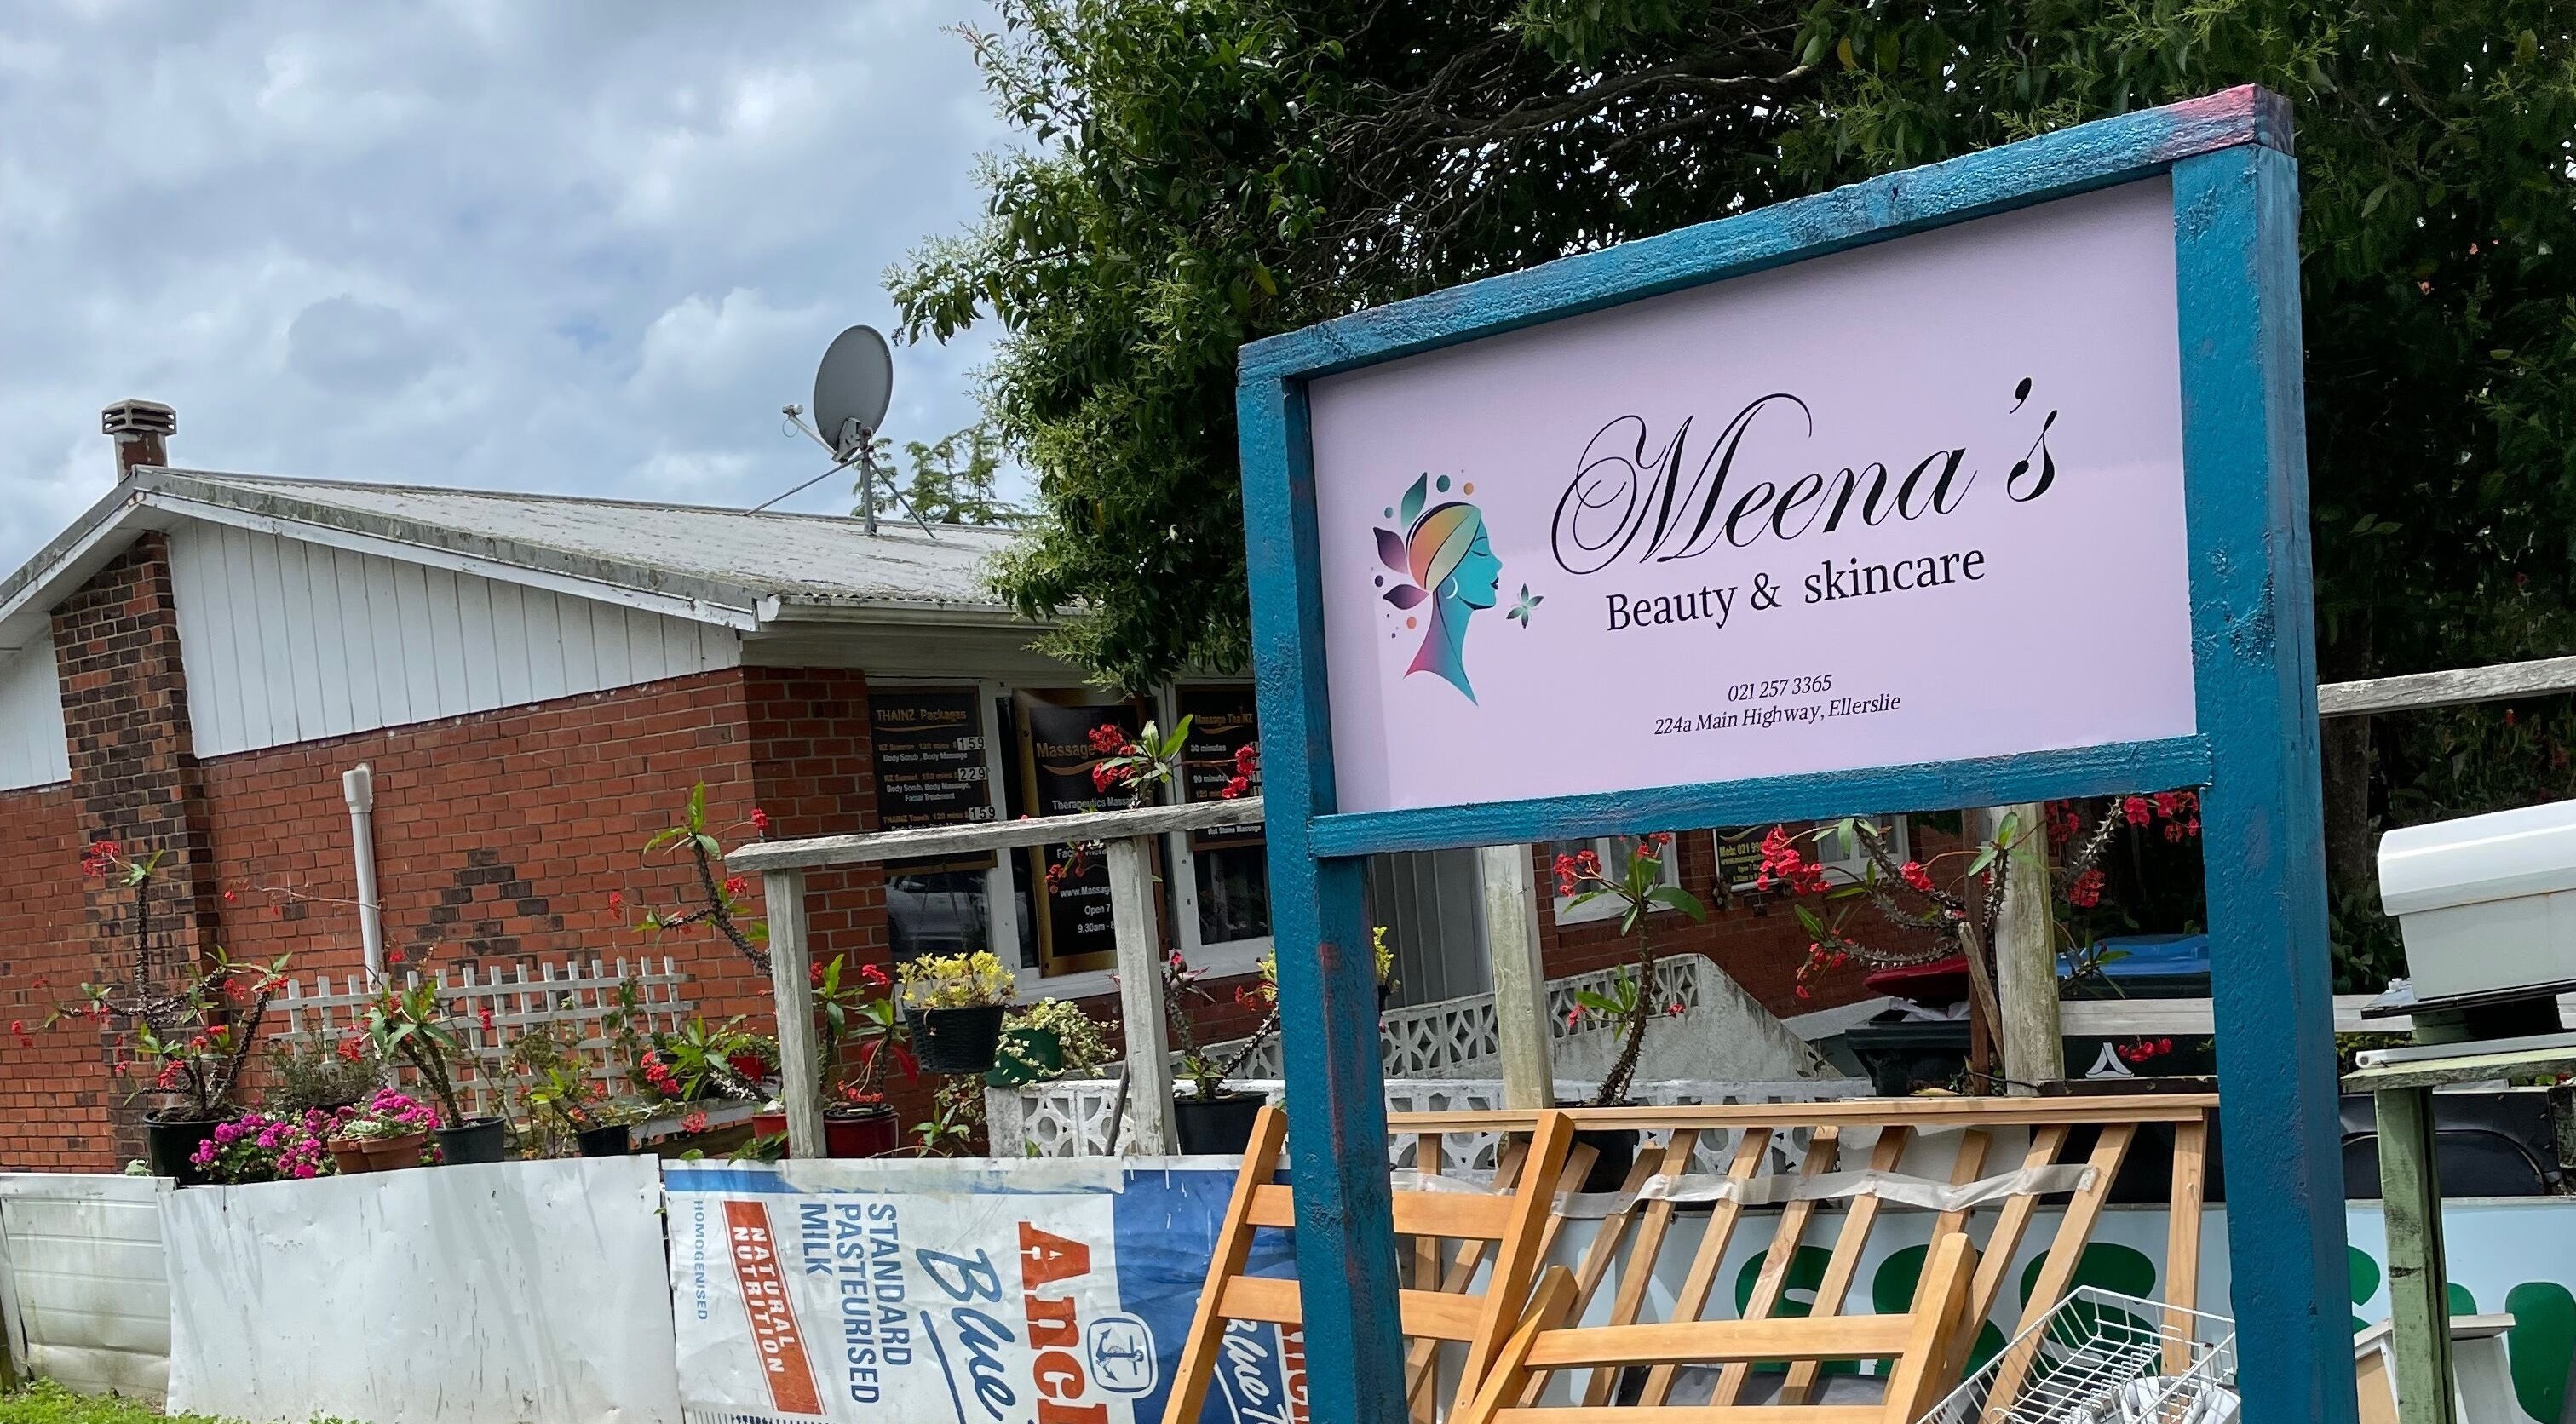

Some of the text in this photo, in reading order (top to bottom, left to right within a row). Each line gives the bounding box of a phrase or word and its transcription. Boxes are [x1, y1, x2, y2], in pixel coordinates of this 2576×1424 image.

[1606, 548, 1987, 632] Beauty & skincare
[920, 708, 967, 722] Packages
[1653, 692, 1901, 736] 224a Main Highway, Ellerslie
[1728, 674, 1833, 703] 021 257 3365
[1078, 922, 1105, 933] 9.30am
[1084, 905, 1105, 916] Open
[693, 1199, 709, 1321] HOMOGENISED
[799, 1203, 834, 1277] MILK
[733, 1226, 785, 1374] NUTRITION
[750, 1226, 796, 1348] NATURAL
[833, 1203, 881, 1404] PASTEURISED
[867, 1203, 913, 1366] STANDARD
[916, 1248, 1016, 1421] Blue
